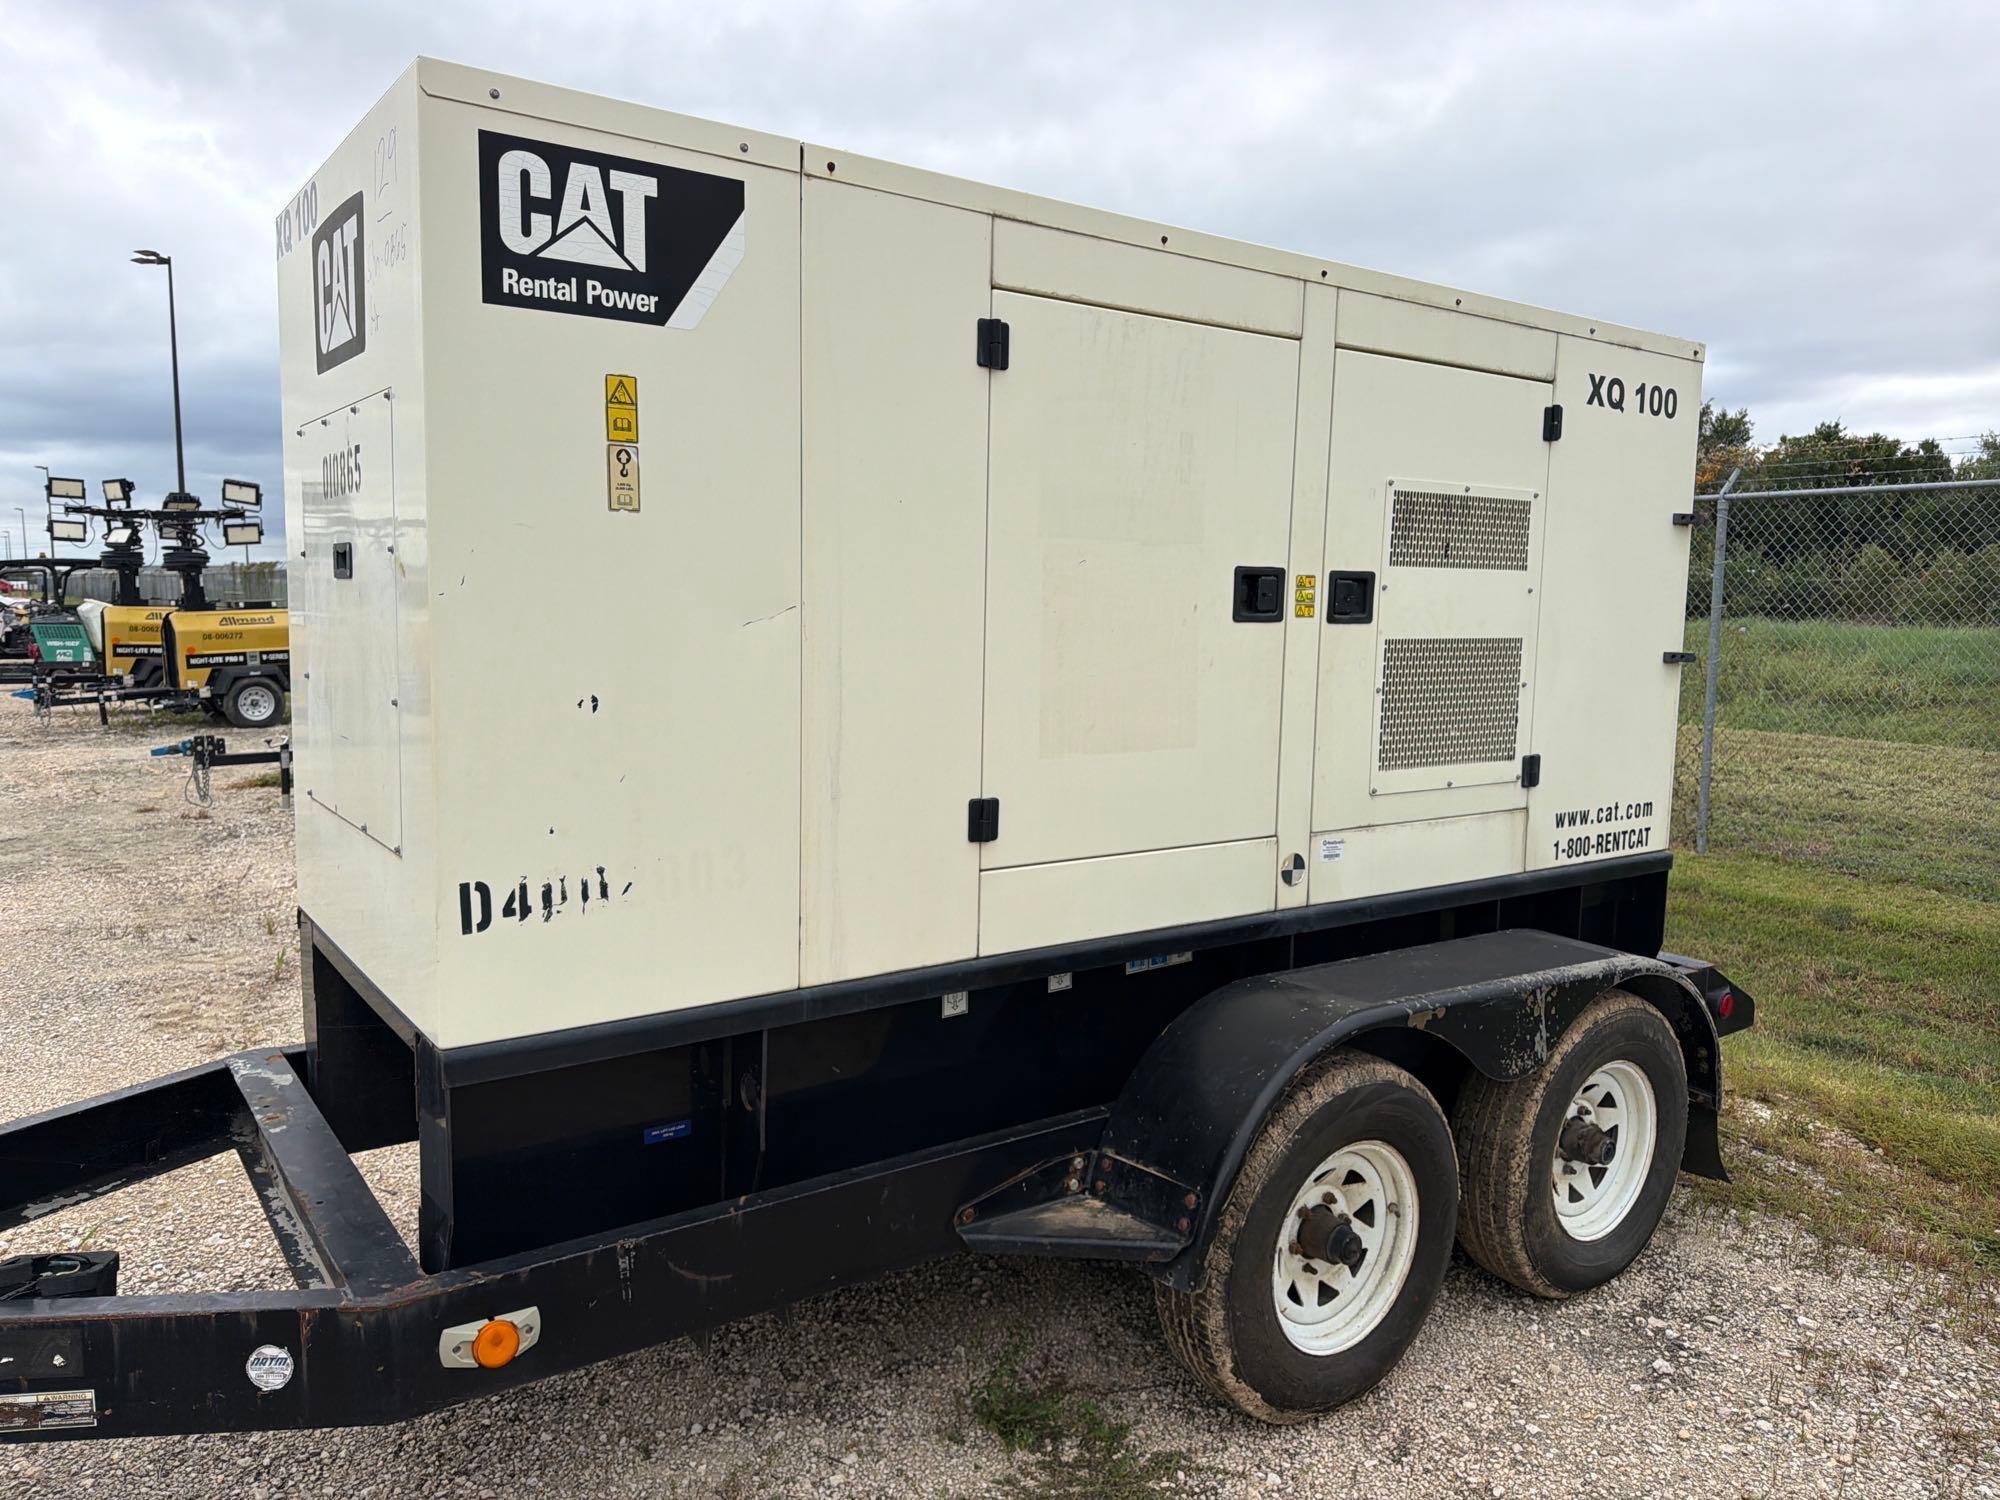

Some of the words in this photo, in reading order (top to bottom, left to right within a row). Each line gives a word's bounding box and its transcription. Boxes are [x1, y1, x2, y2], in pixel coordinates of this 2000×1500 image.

[373, 126, 398, 203] 129
[276, 209, 293, 262] XQ
[296, 181, 318, 241] 100
[498, 150, 658, 273] CAT
[318, 213, 358, 355] CAT
[502, 267, 577, 303] Rental
[586, 279, 659, 313] Power
[1586, 373, 1625, 414] XQ
[1635, 382, 1678, 419] 100
[323, 444, 361, 500] 010865
[219, 615, 275, 626] Allmand
[189, 656, 223, 665] NIGHT-LITE
[1555, 801, 1653, 829] www.cat.com
[1553, 827, 1651, 860] 1-800-RENTCAT
[51, 1392, 87, 1401] WARNING
